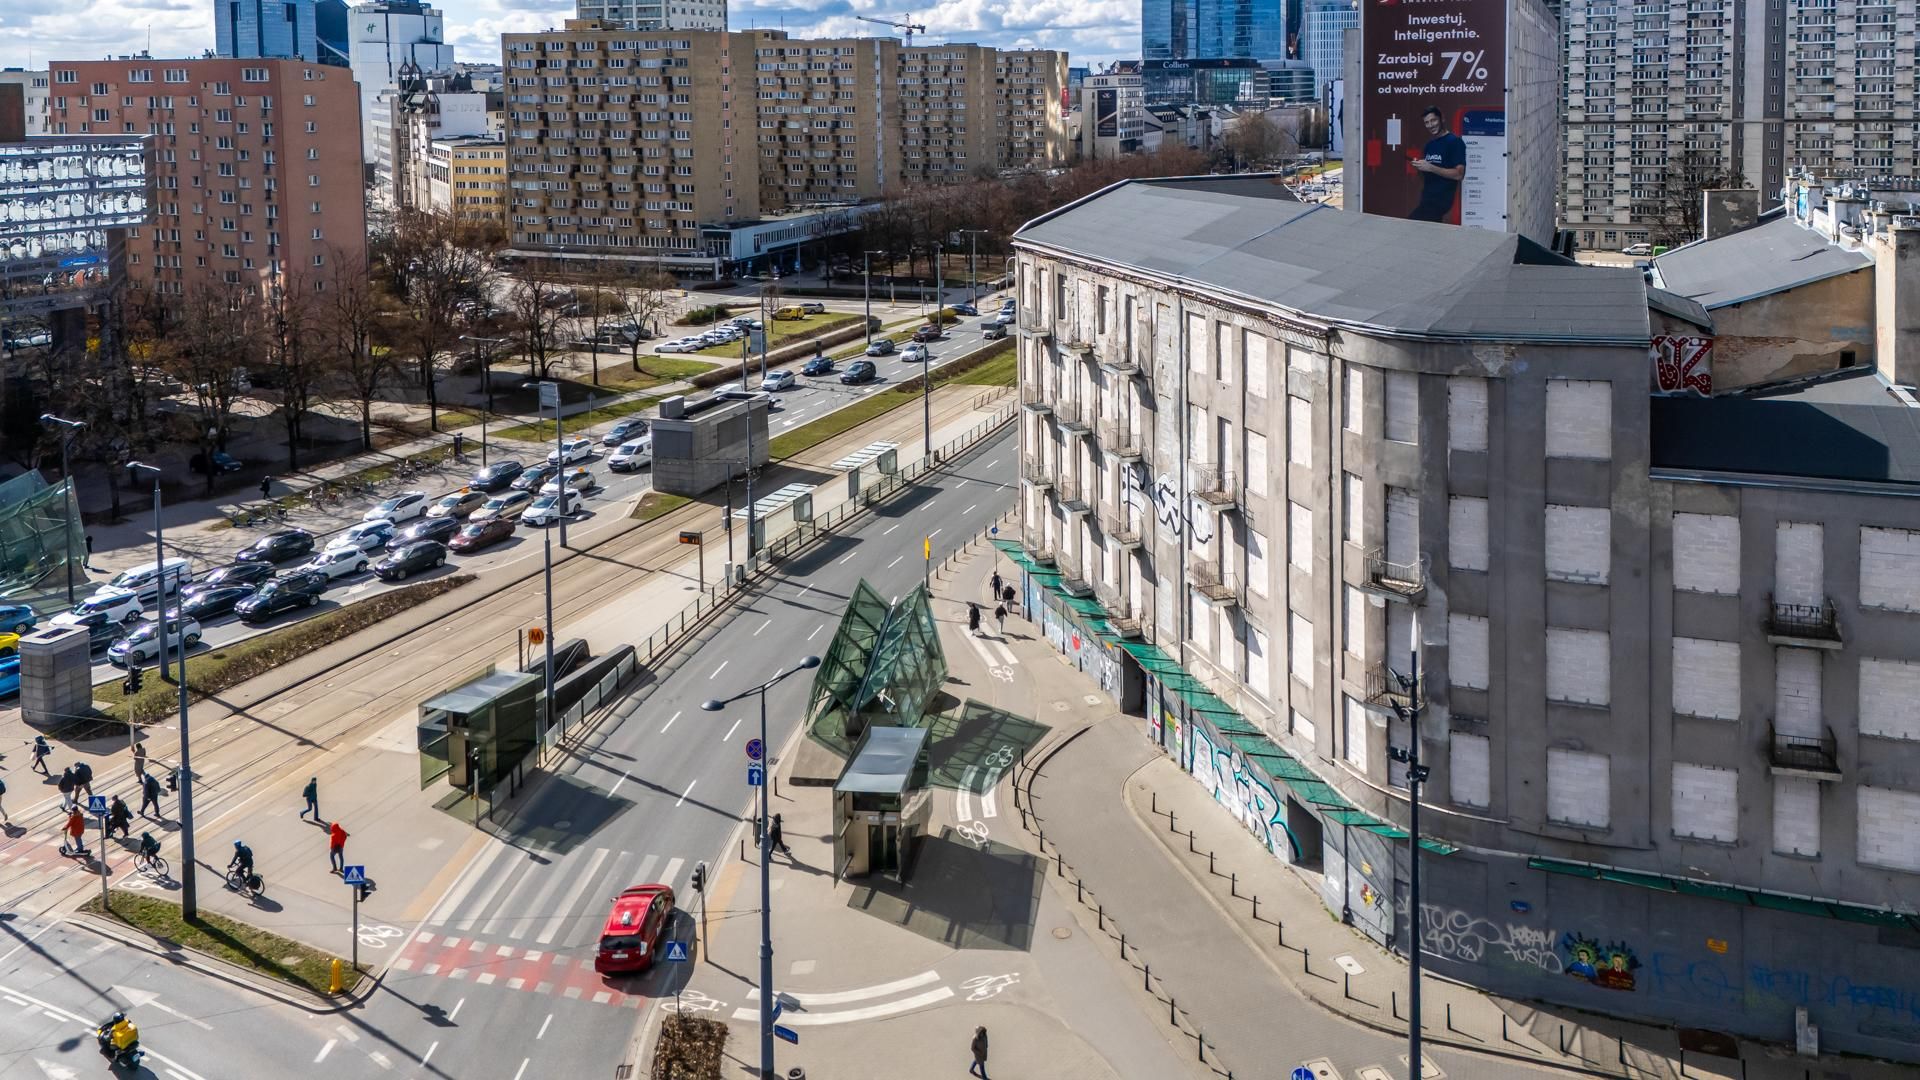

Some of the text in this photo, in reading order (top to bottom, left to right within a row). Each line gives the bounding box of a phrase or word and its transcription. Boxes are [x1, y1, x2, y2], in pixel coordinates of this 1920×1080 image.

[1408, 13, 1466, 26] Inwestuj.
[1394, 28, 1480, 42] Inteligentnie.
[1162, 61, 1190, 69] Colliers
[1378, 52, 1433, 66] Zarabiaj
[1441, 50, 1488, 80] 7%
[1378, 69, 1418, 80] nawet
[1378, 85, 1391, 94] od
[1393, 84, 1437, 96] wolnych
